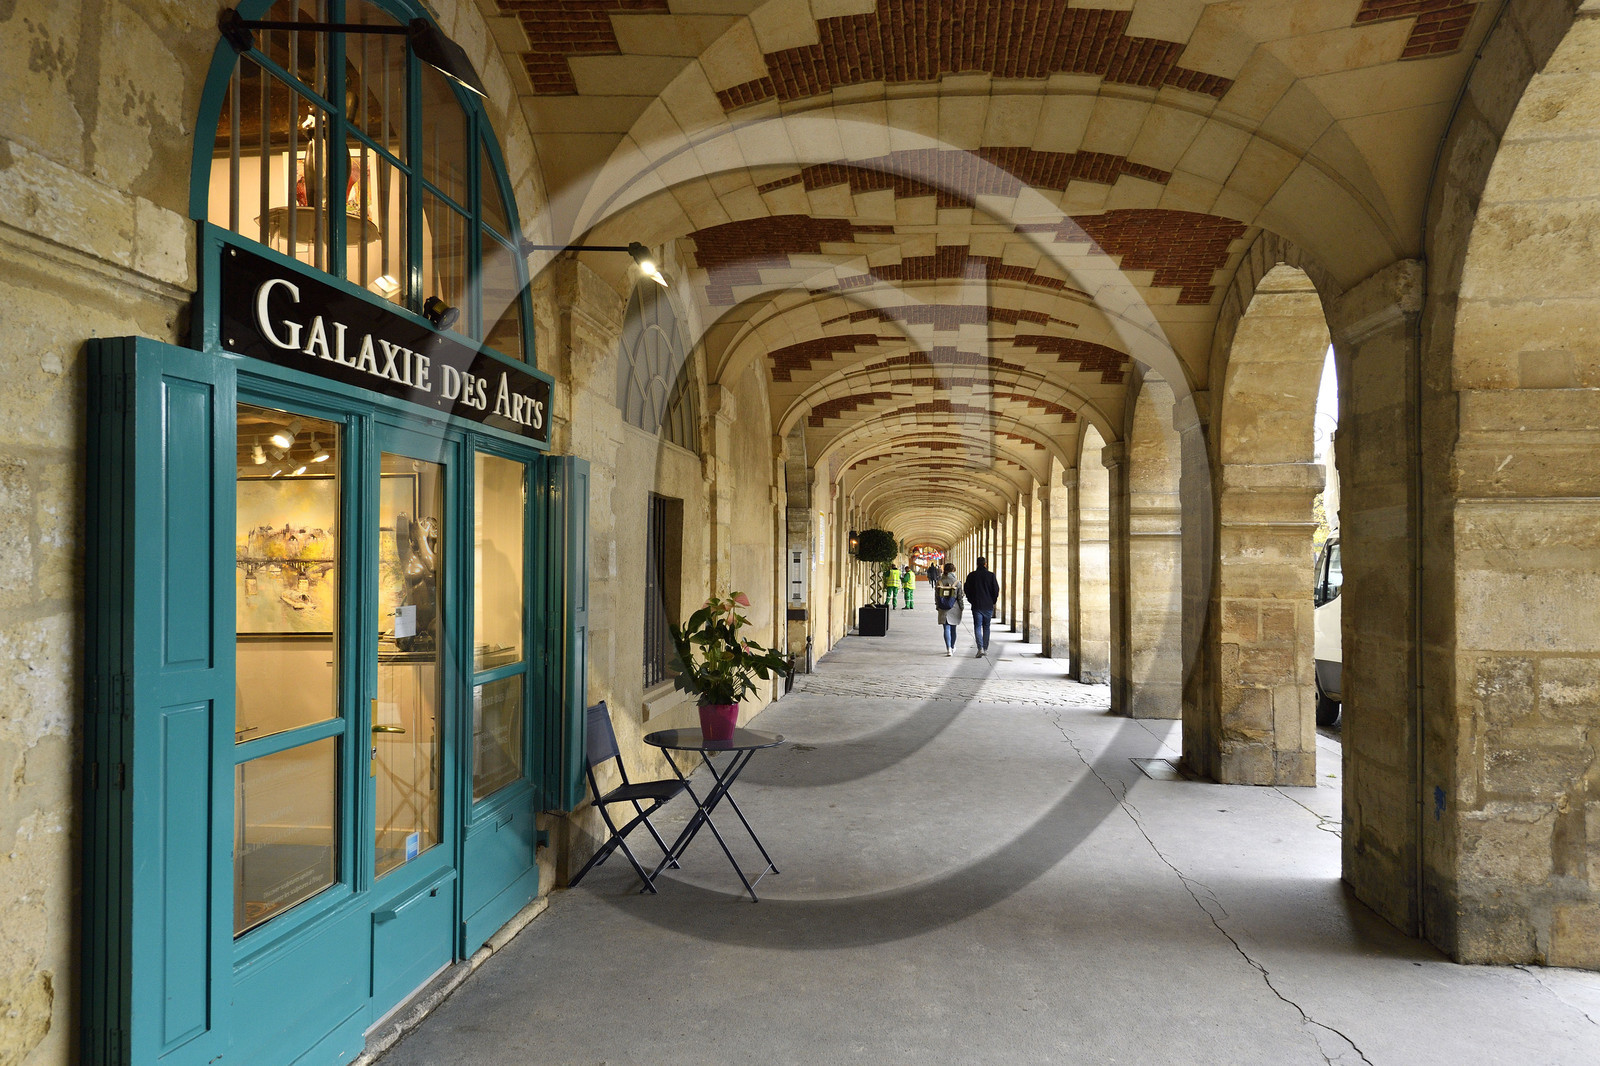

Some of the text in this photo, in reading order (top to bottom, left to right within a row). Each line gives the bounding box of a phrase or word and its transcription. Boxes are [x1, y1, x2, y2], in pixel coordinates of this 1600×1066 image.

[256, 278, 543, 430] GALAXIE DES ARTS
